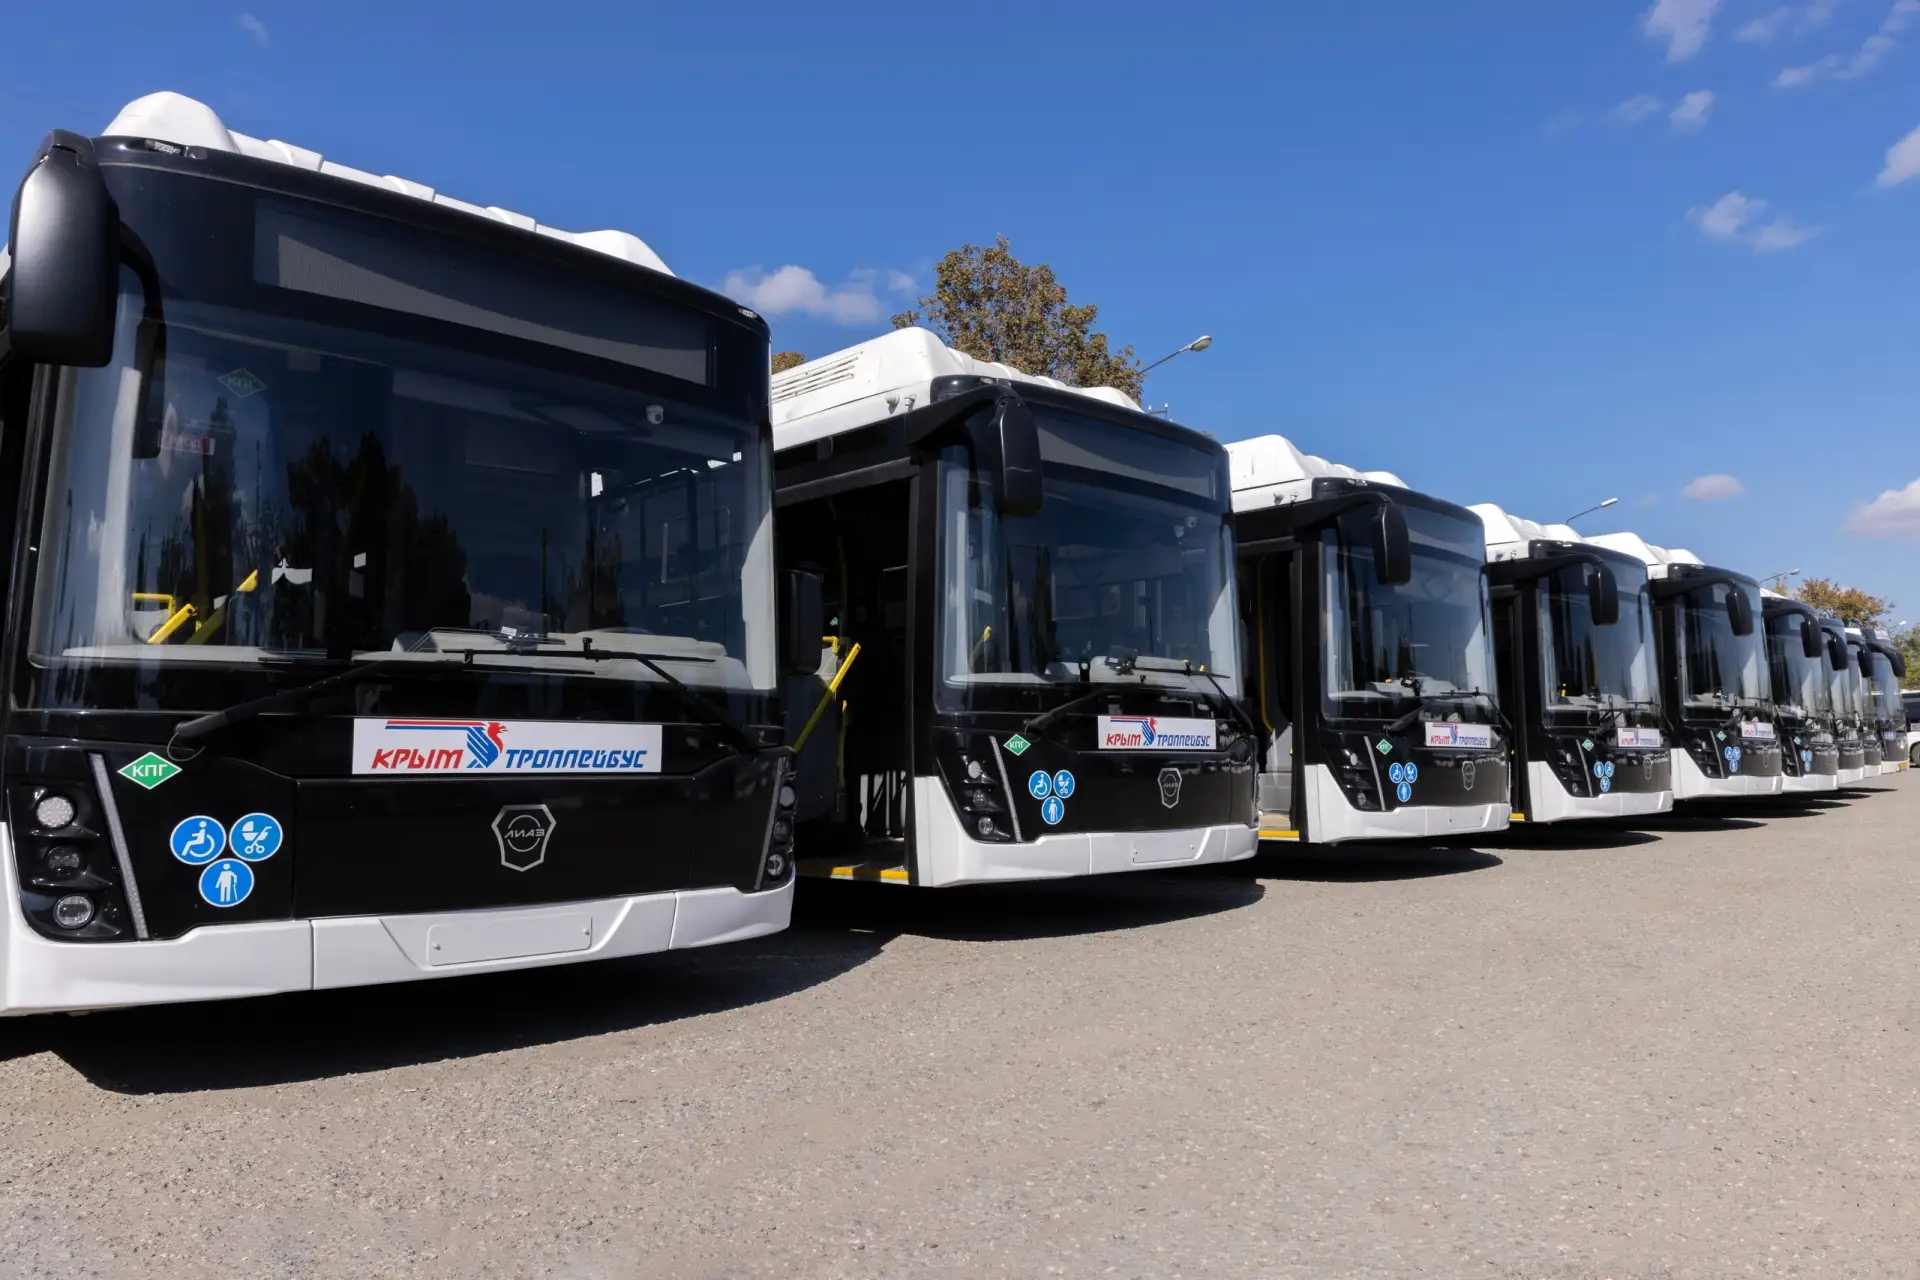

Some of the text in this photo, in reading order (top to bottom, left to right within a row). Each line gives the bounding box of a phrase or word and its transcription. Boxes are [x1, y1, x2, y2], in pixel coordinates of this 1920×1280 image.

[1105, 733, 1211, 747] КРЫМ ТРОЛЛЕЙБУС
[371, 748, 648, 769] КРЫМ ТРОЛЛЕЙБУС
[132, 764, 168, 777] КПГ
[504, 828, 545, 839] ЛИАЗ
